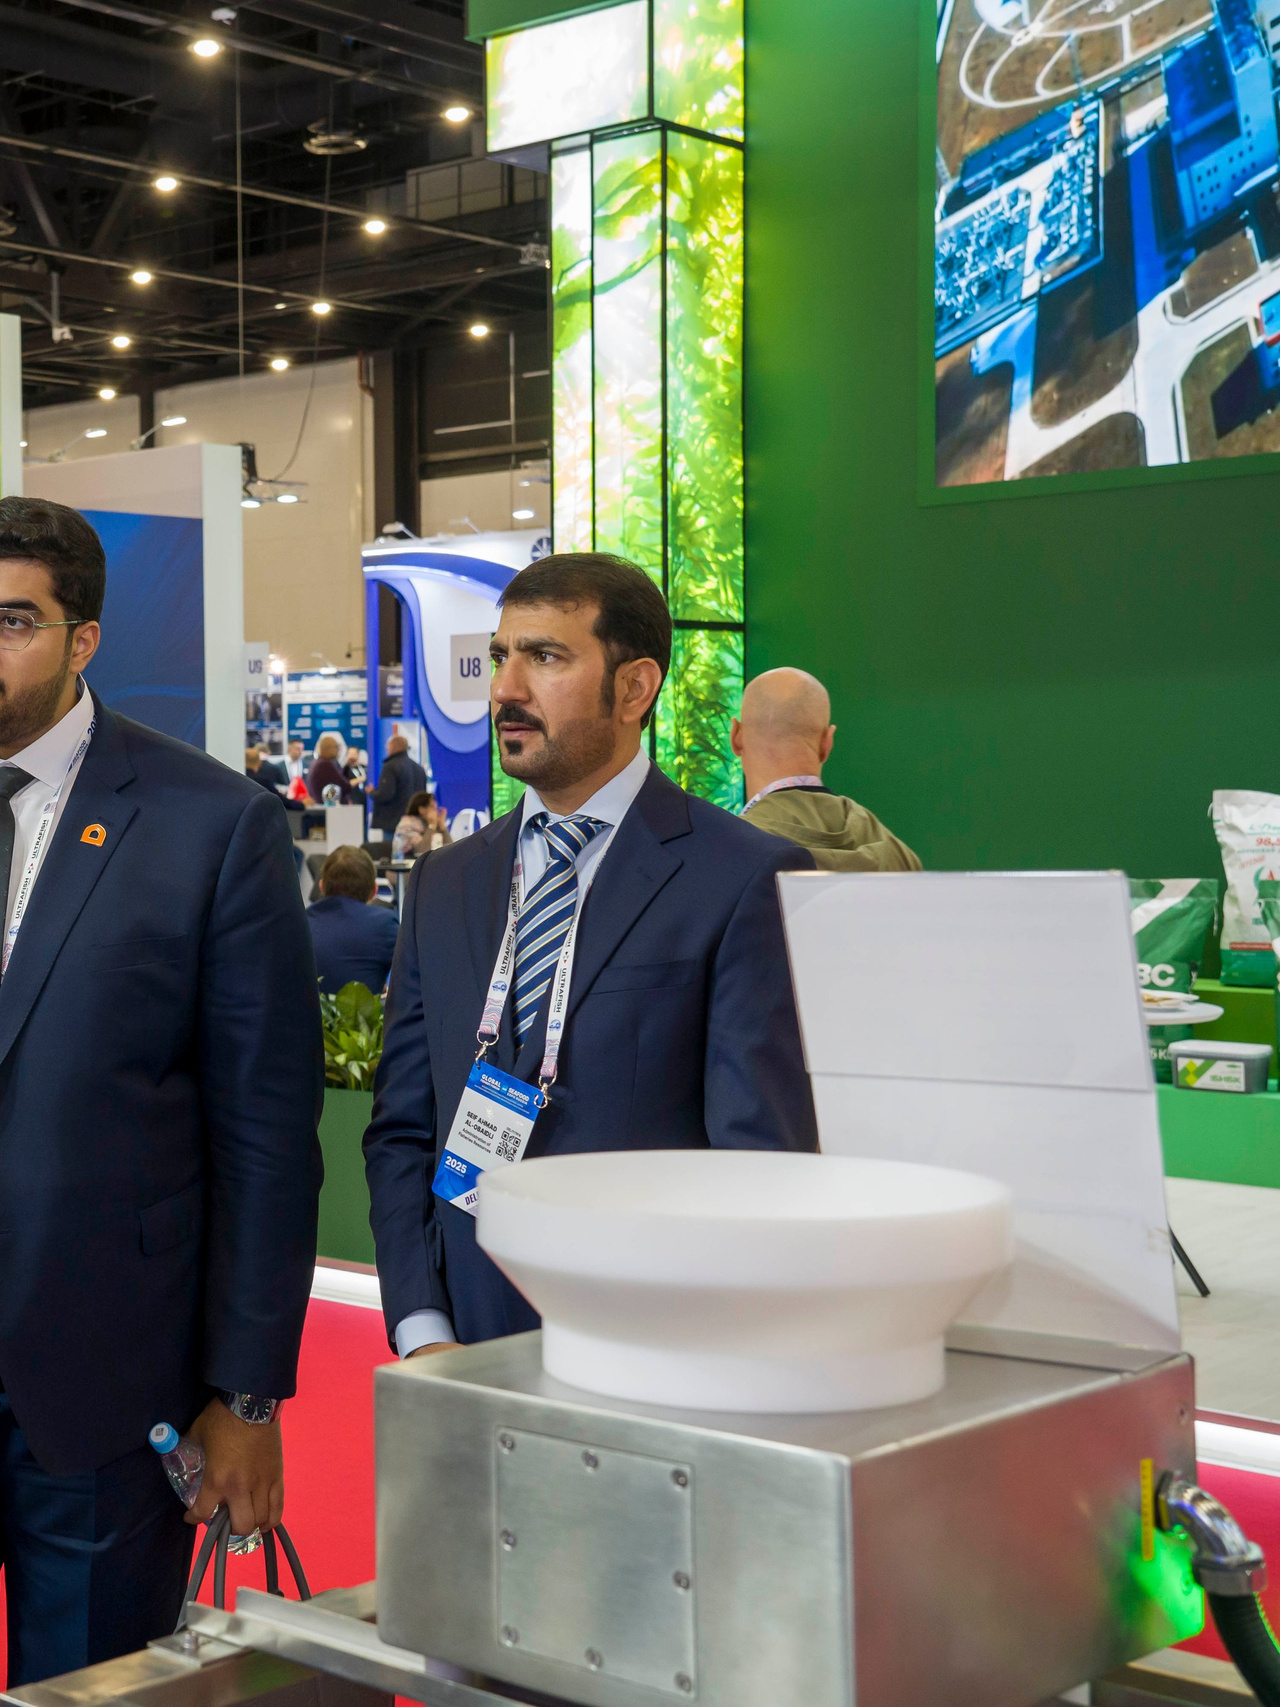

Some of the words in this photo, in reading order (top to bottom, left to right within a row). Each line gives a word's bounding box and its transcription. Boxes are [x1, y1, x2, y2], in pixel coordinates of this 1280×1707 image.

[459, 657, 482, 678] U8
[31, 819, 48, 859] ULTRAFISH
[15, 877, 30, 919] ULTRAFISH
[499, 934, 513, 975] ULTRAFISH
[556, 968, 568, 1014] ULTRAFISH
[481, 1073, 501, 1087] GLOBAL
[508, 1087, 530, 1102] SEAFOOD
[465, 1119, 494, 1140] AL-OBAIDLI
[466, 1111, 478, 1120] SEIF
[477, 1117, 498, 1132] AHMAD
[458, 1131, 473, 1143] Fisheries
[473, 1140, 491, 1153] Resources
[462, 1128, 487, 1144] Administration
[445, 1155, 468, 1174] 2025
